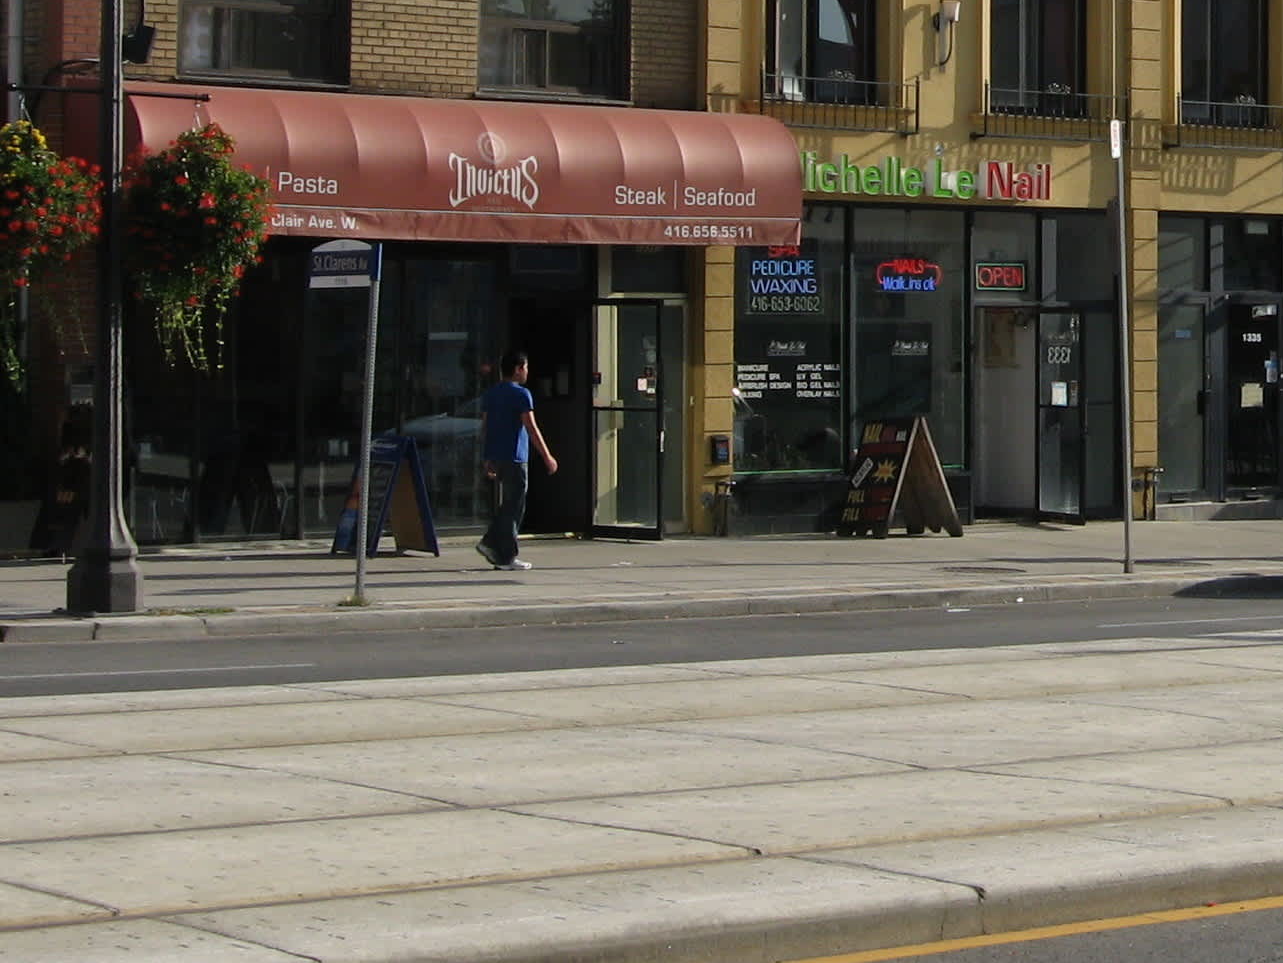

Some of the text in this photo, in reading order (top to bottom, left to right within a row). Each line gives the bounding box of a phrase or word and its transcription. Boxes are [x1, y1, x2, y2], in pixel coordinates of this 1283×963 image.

[278, 171, 338, 195] Pasta
[801, 151, 1052, 201] ichelle Le Nail
[615, 185, 756, 207] Steak Seafood
[308, 215, 337, 229] Ave.
[341, 217, 360, 230] W.
[664, 225, 753, 238] 416.656.5511
[752, 260, 815, 276] PEDICURE
[894, 259, 925, 274] NAILS
[978, 266, 1023, 285] OPEN
[751, 278, 817, 294] WAXING
[751, 296, 820, 312] 416-653-6062
[1242, 333, 1262, 343] 1335
[769, 381, 792, 389] DESIGN
